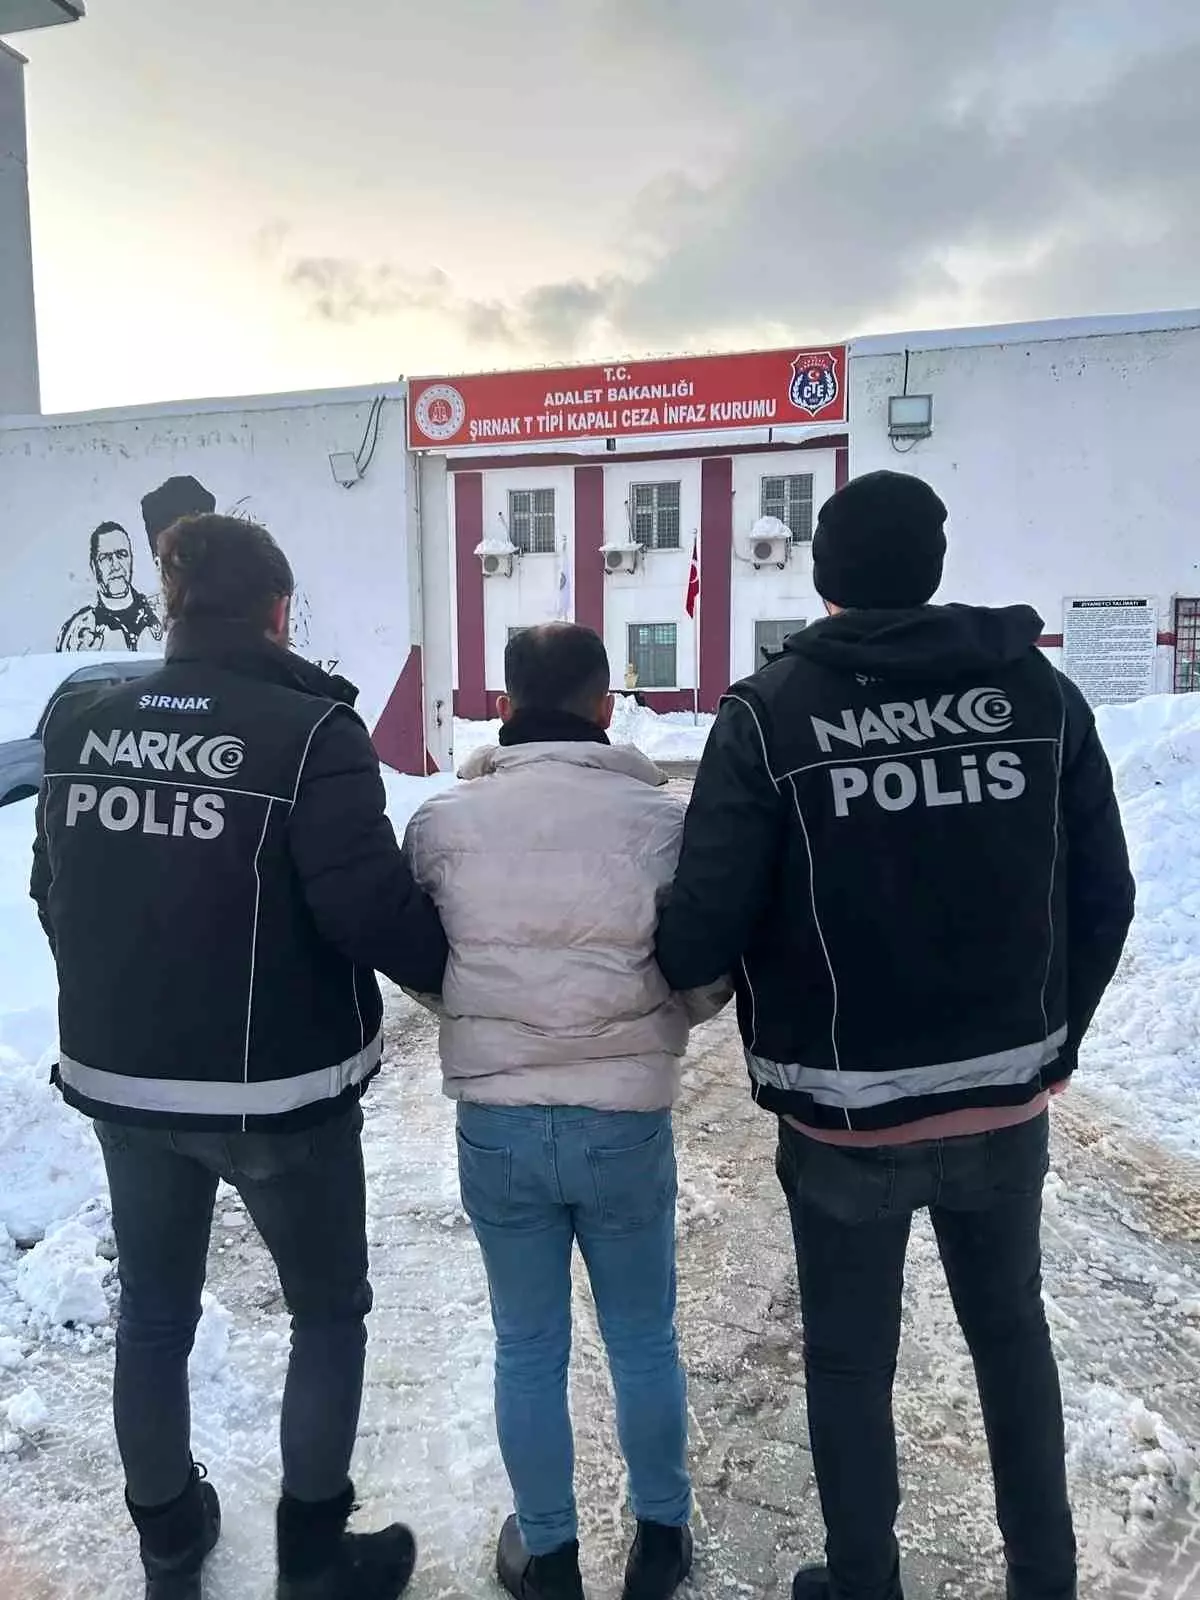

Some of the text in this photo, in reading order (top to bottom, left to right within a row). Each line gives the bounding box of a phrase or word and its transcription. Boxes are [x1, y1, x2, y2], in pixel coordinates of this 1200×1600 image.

[603, 367, 631, 382] T.C.
[544, 379, 694, 406] ADALET BAKANLIĞI
[803, 381, 824, 398] CTE
[470, 398, 777, 441] ŞIRNAK T TİPİ KAPALI CEZA İNFAZ KURUMU
[138, 694, 212, 710] ŞIRNAK
[809, 687, 1014, 752] NARKO
[79, 729, 246, 779] NARKO
